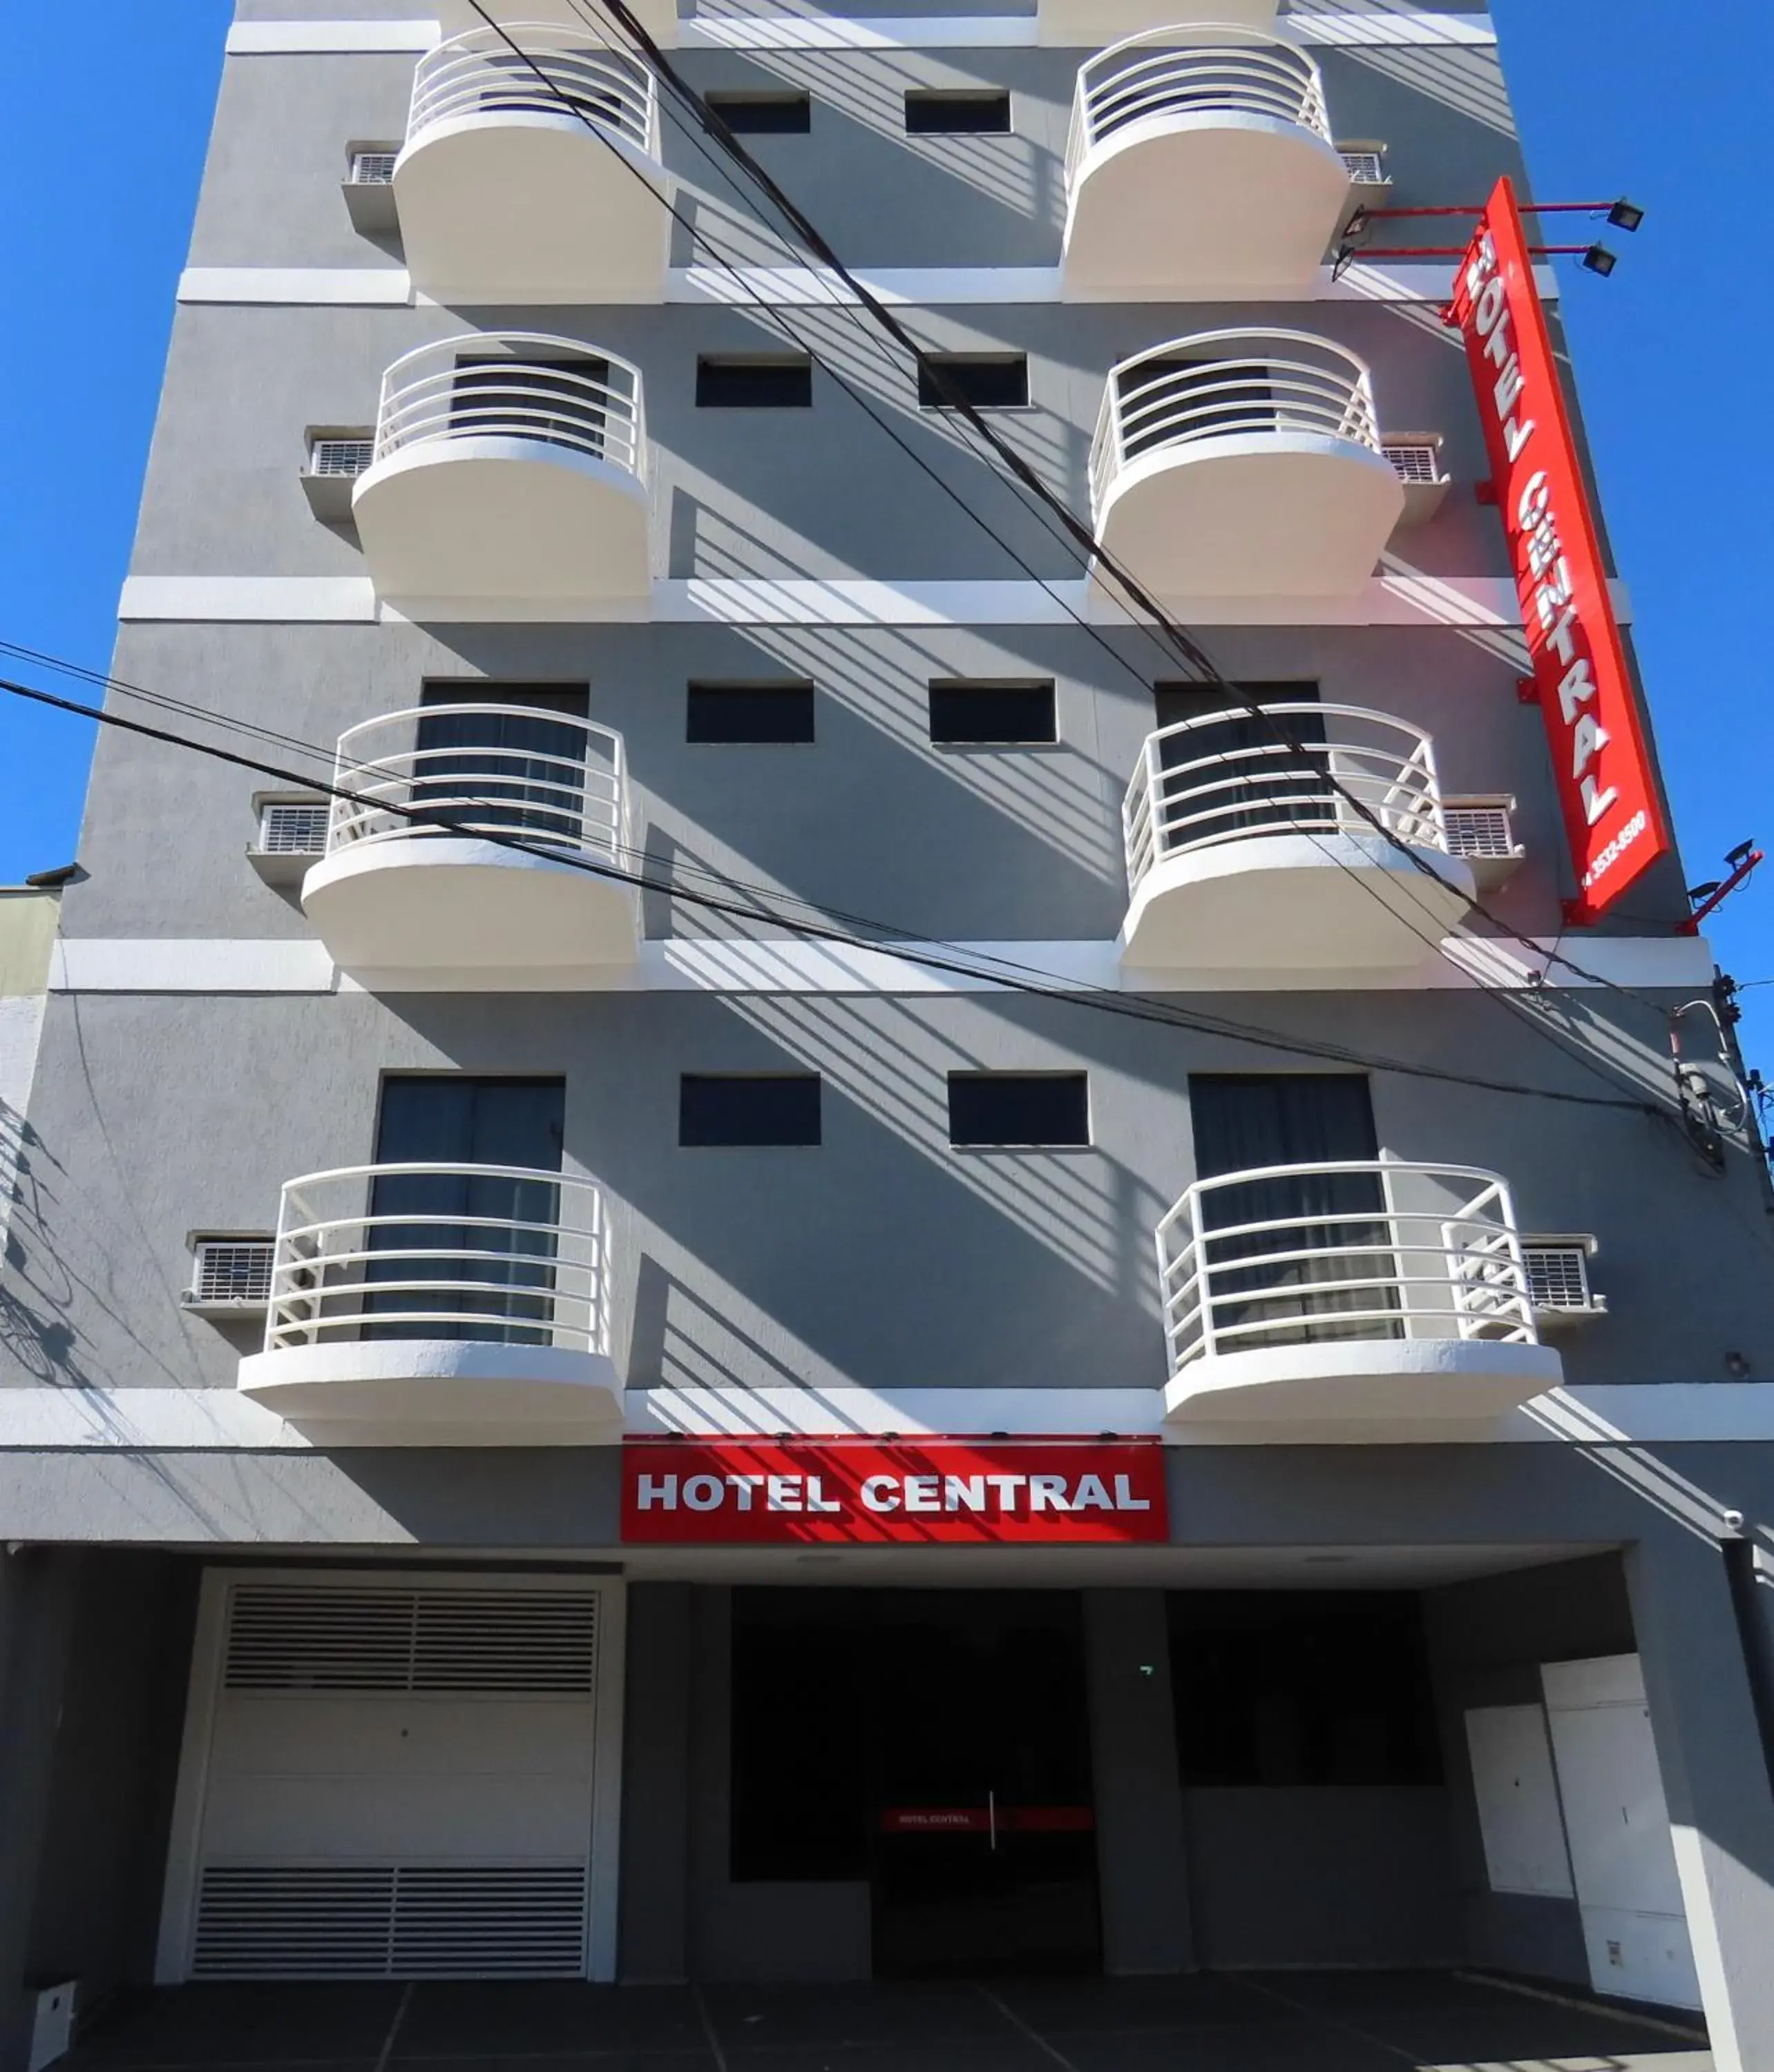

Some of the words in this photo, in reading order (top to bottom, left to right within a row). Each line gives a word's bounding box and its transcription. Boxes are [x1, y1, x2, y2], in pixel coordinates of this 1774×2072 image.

[1467, 229, 1536, 463] HOTEL
[1518, 470, 1619, 825] CENTRAL
[637, 1474, 841, 1511] HOTEL
[859, 1474, 1151, 1511] CENTRAL
